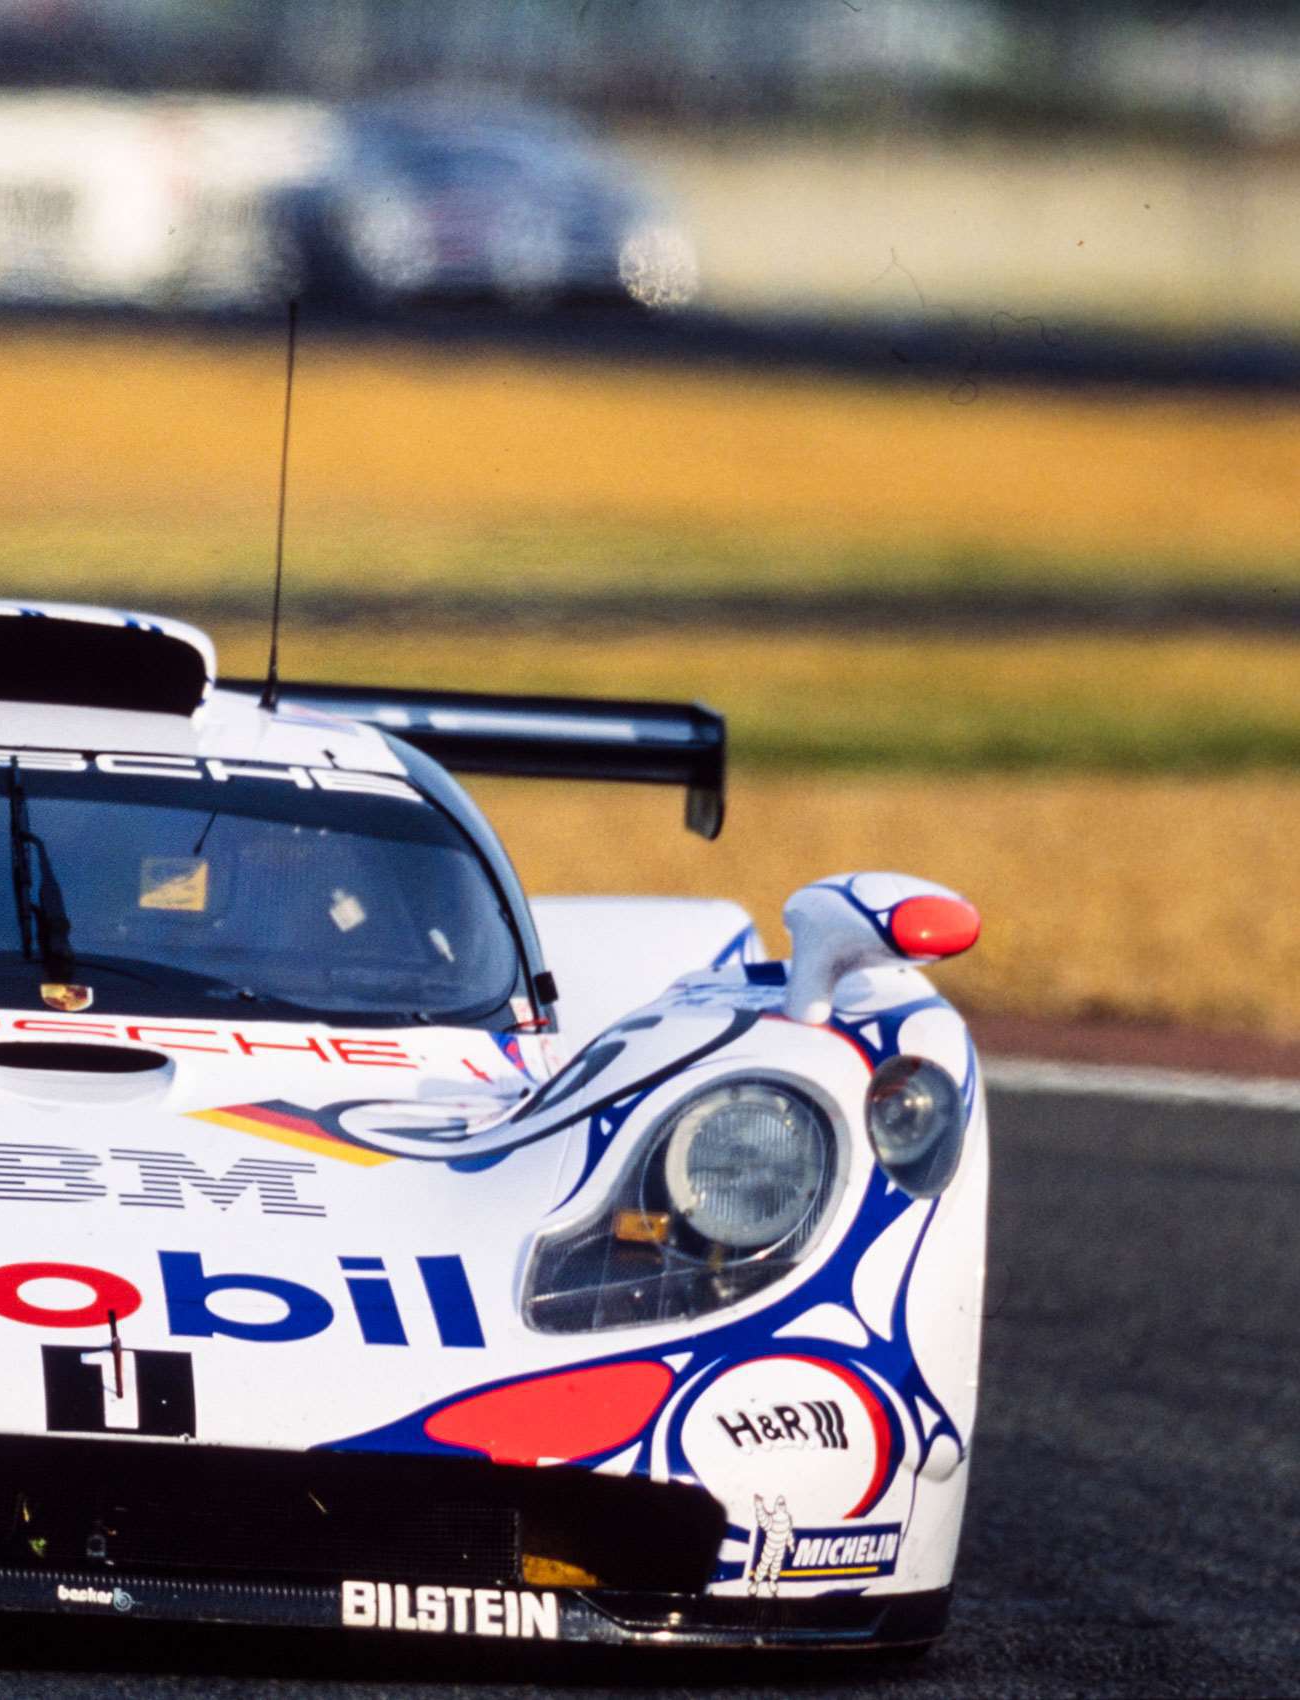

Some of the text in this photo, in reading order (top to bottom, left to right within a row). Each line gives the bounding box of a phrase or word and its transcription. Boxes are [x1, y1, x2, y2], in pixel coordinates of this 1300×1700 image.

[80, 1349, 140, 1430] 1
[792, 1534, 899, 1567] MICHELIN
[57, 1584, 113, 1604] becker
[341, 1581, 558, 1639] BILSTEIN
